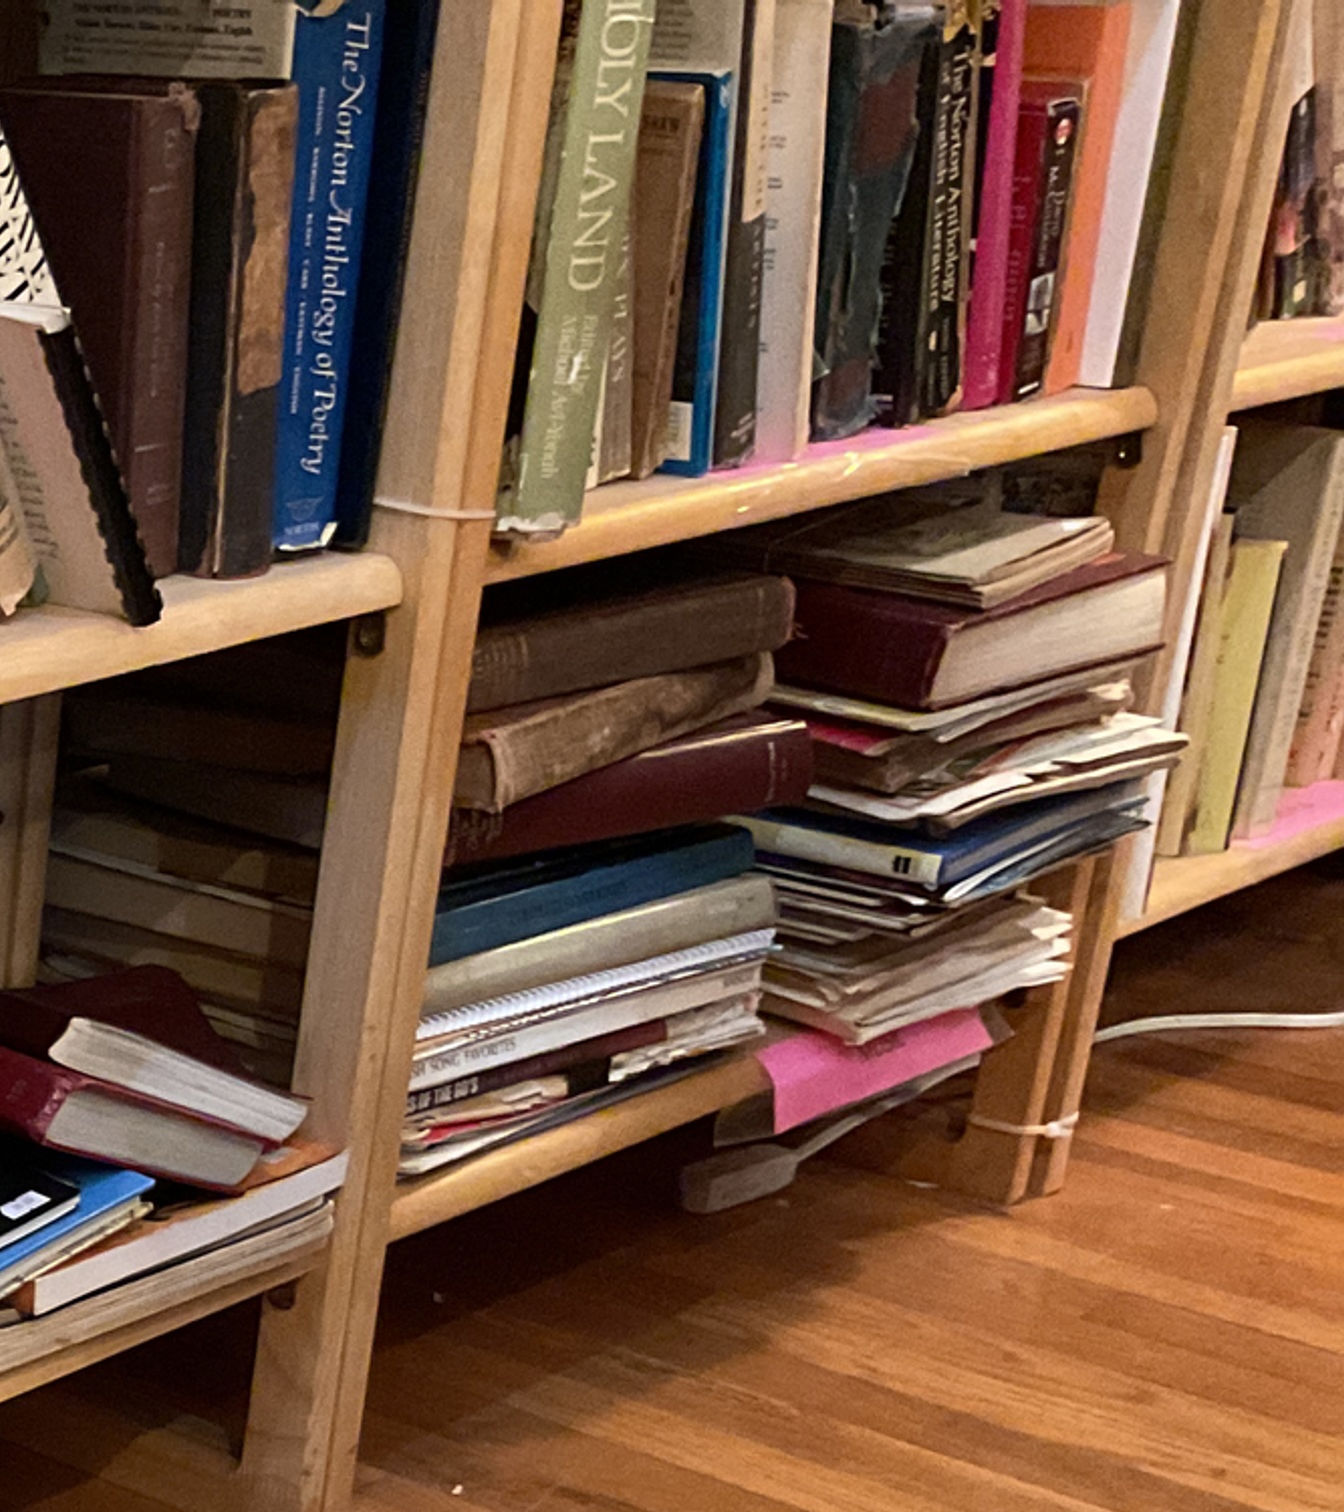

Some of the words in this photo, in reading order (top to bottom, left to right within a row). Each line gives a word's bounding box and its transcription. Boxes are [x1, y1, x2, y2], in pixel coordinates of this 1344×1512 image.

[341, 12, 372, 73] The
[329, 75, 366, 186] Norton
[948, 97, 969, 182] Norton
[568, 133, 624, 292] LAND
[941, 187, 963, 303] Anthology
[313, 188, 354, 347] Anthology
[310, 352, 339, 381] of
[300, 384, 338, 476] Poetry
